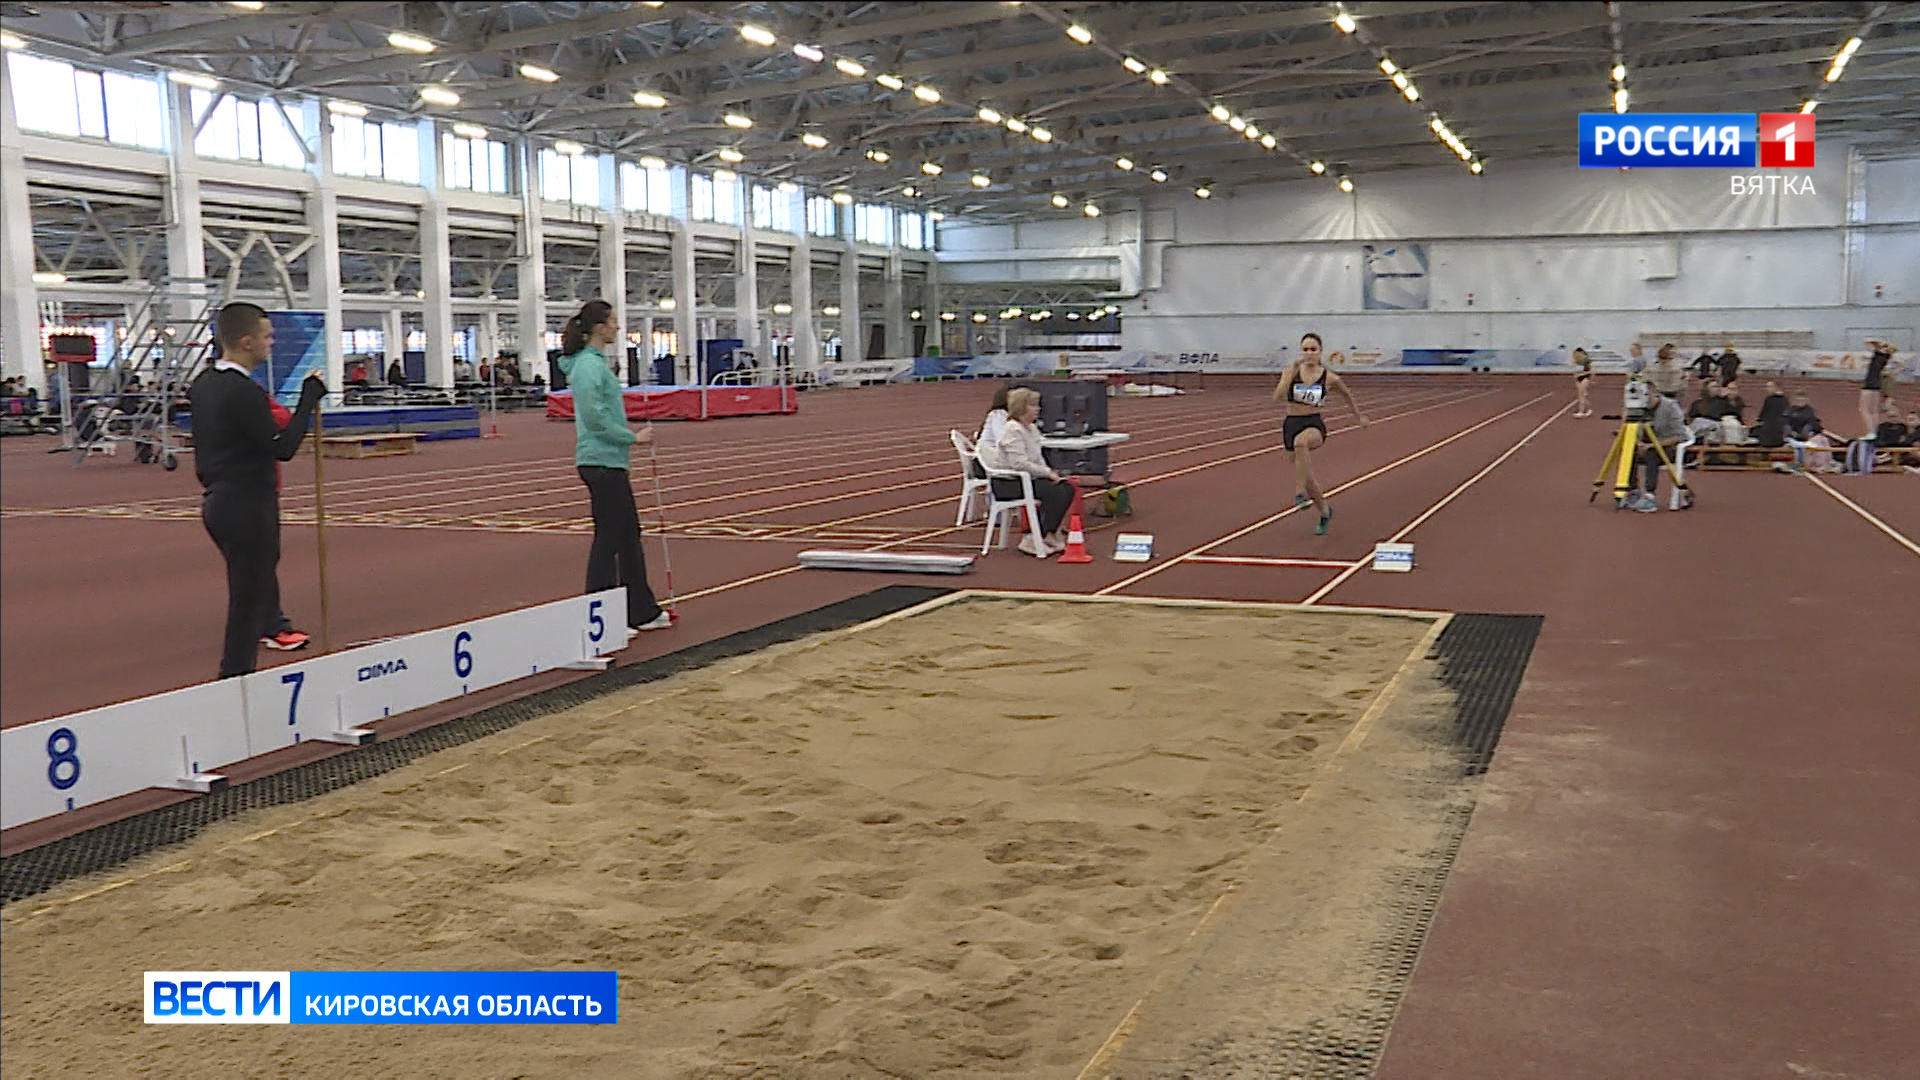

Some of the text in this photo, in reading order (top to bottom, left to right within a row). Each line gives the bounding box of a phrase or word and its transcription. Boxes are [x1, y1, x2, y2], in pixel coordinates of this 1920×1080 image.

[587, 600, 605, 642] 5
[357, 657, 409, 682] DIMA
[453, 631, 473, 678] 6
[281, 672, 305, 726] 7
[47, 727, 82, 790] 8
